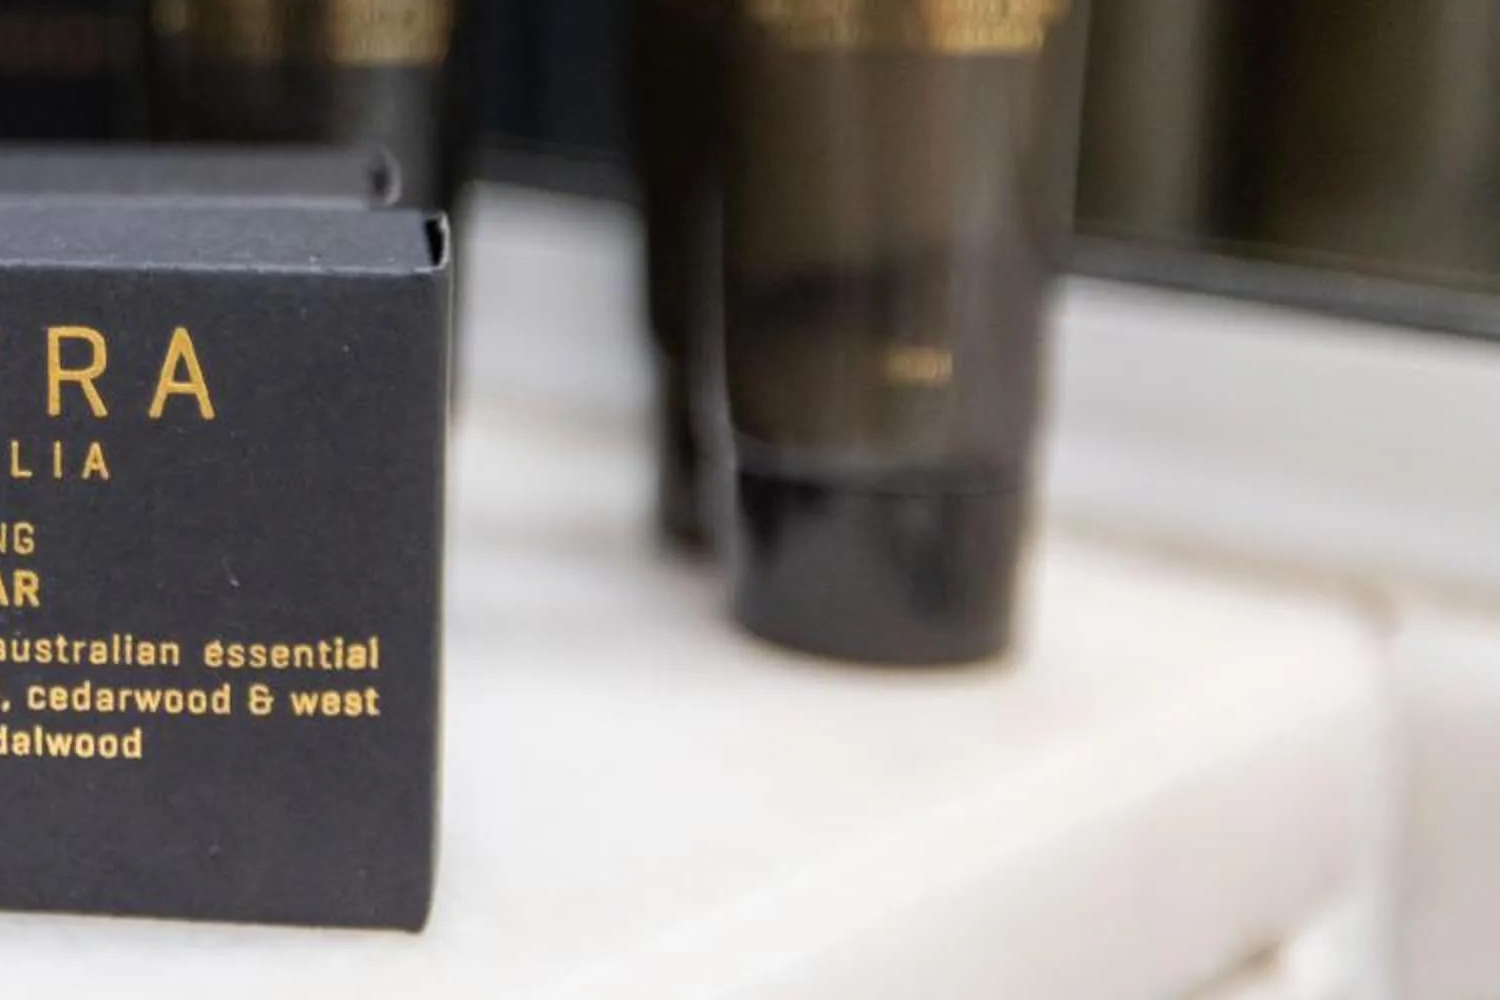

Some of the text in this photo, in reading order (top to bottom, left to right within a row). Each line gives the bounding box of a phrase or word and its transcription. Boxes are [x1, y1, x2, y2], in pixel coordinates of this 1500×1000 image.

[202, 635, 380, 671] essential
[26, 681, 232, 716] cedarwood
[246, 682, 274, 716] &
